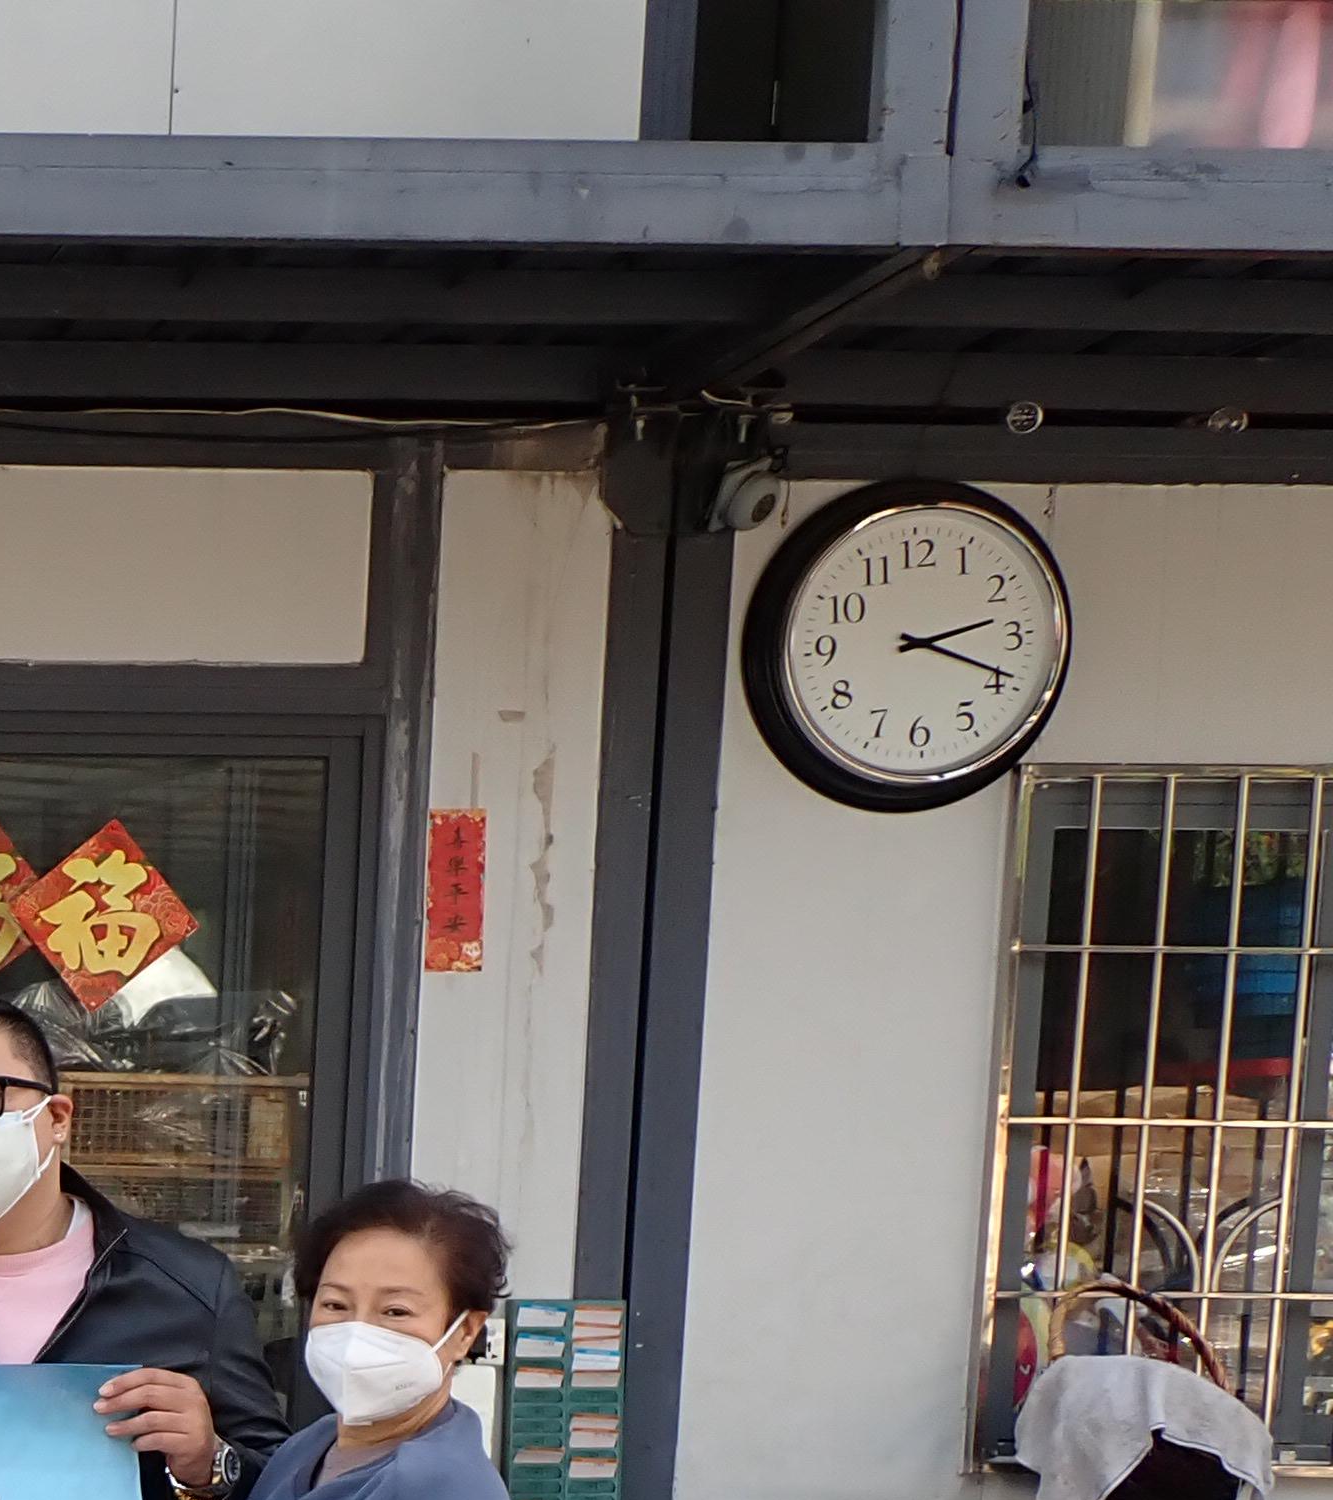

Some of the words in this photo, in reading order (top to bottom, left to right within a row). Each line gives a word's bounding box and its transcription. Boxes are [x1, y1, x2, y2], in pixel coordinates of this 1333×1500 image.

[900, 539, 936, 569] 12
[957, 546, 970, 576] 1
[861, 555, 891, 586] 11
[987, 574, 1007, 603] 2
[829, 592, 865, 625] 10
[1003, 621, 1023, 650] 3
[815, 635, 837, 667] 9
[830, 680, 853, 710] 8
[984, 666, 1005, 695] 4
[870, 709, 888, 738] 7
[909, 715, 931, 747] 6
[955, 701, 975, 732] 5
[39, 849, 161, 977] 福
